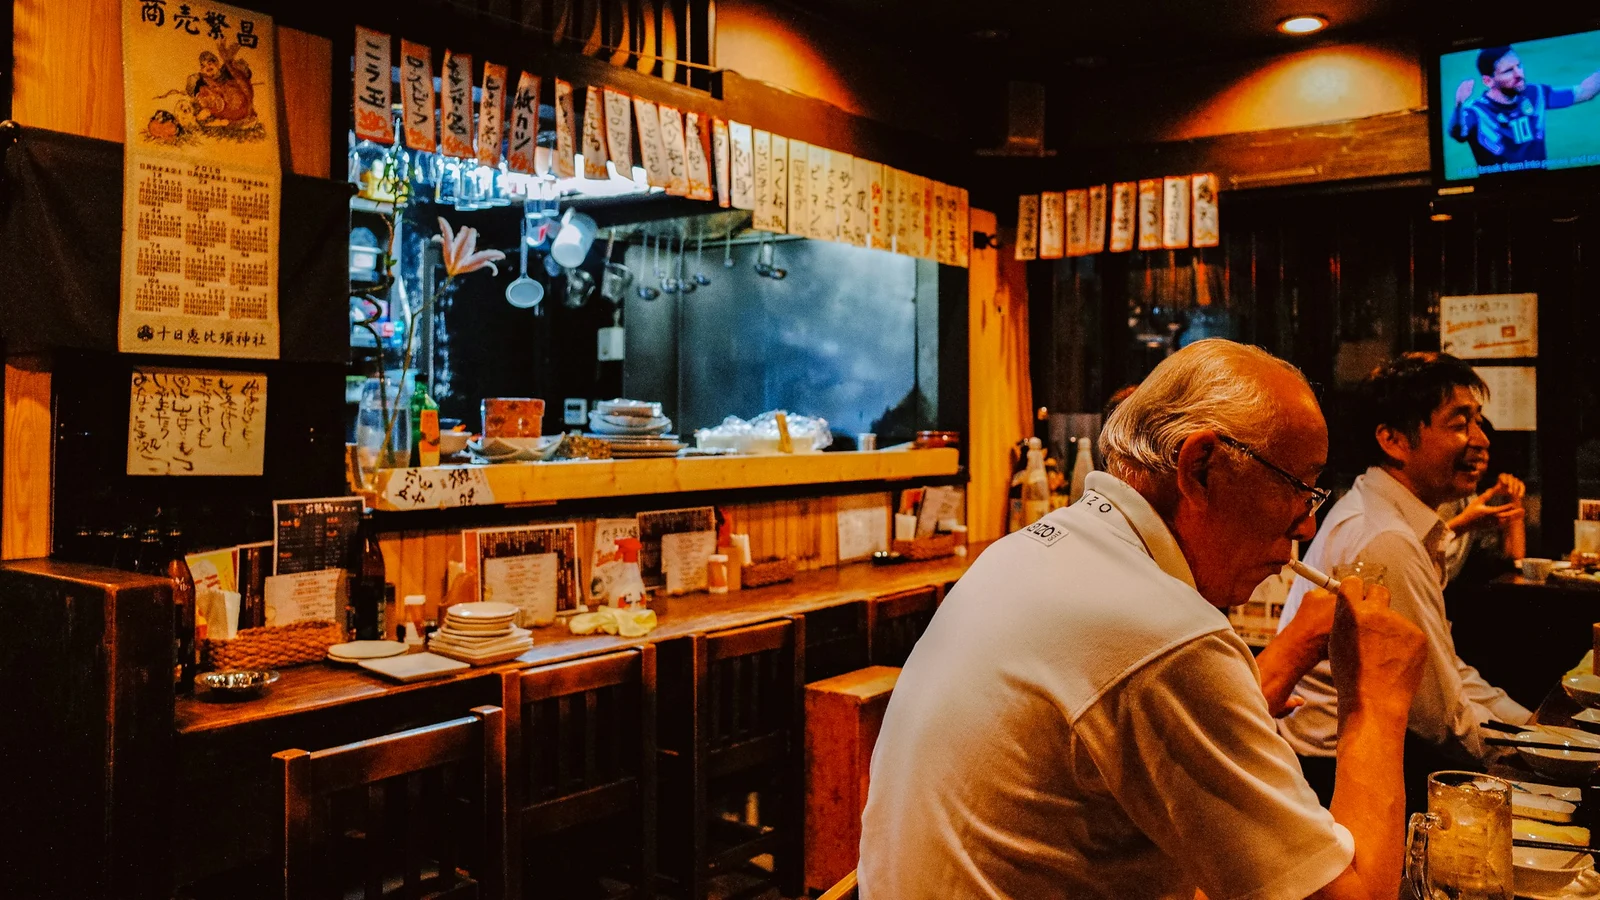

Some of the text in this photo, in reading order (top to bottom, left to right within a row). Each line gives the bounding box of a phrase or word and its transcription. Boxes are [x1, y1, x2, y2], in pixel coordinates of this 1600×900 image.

[359, 39, 386, 110] ニラ玉
[1509, 116, 1534, 144] 10
[773, 158, 784, 209] つくね
[1502, 161, 1524, 171] them
[1524, 159, 1540, 169] into
